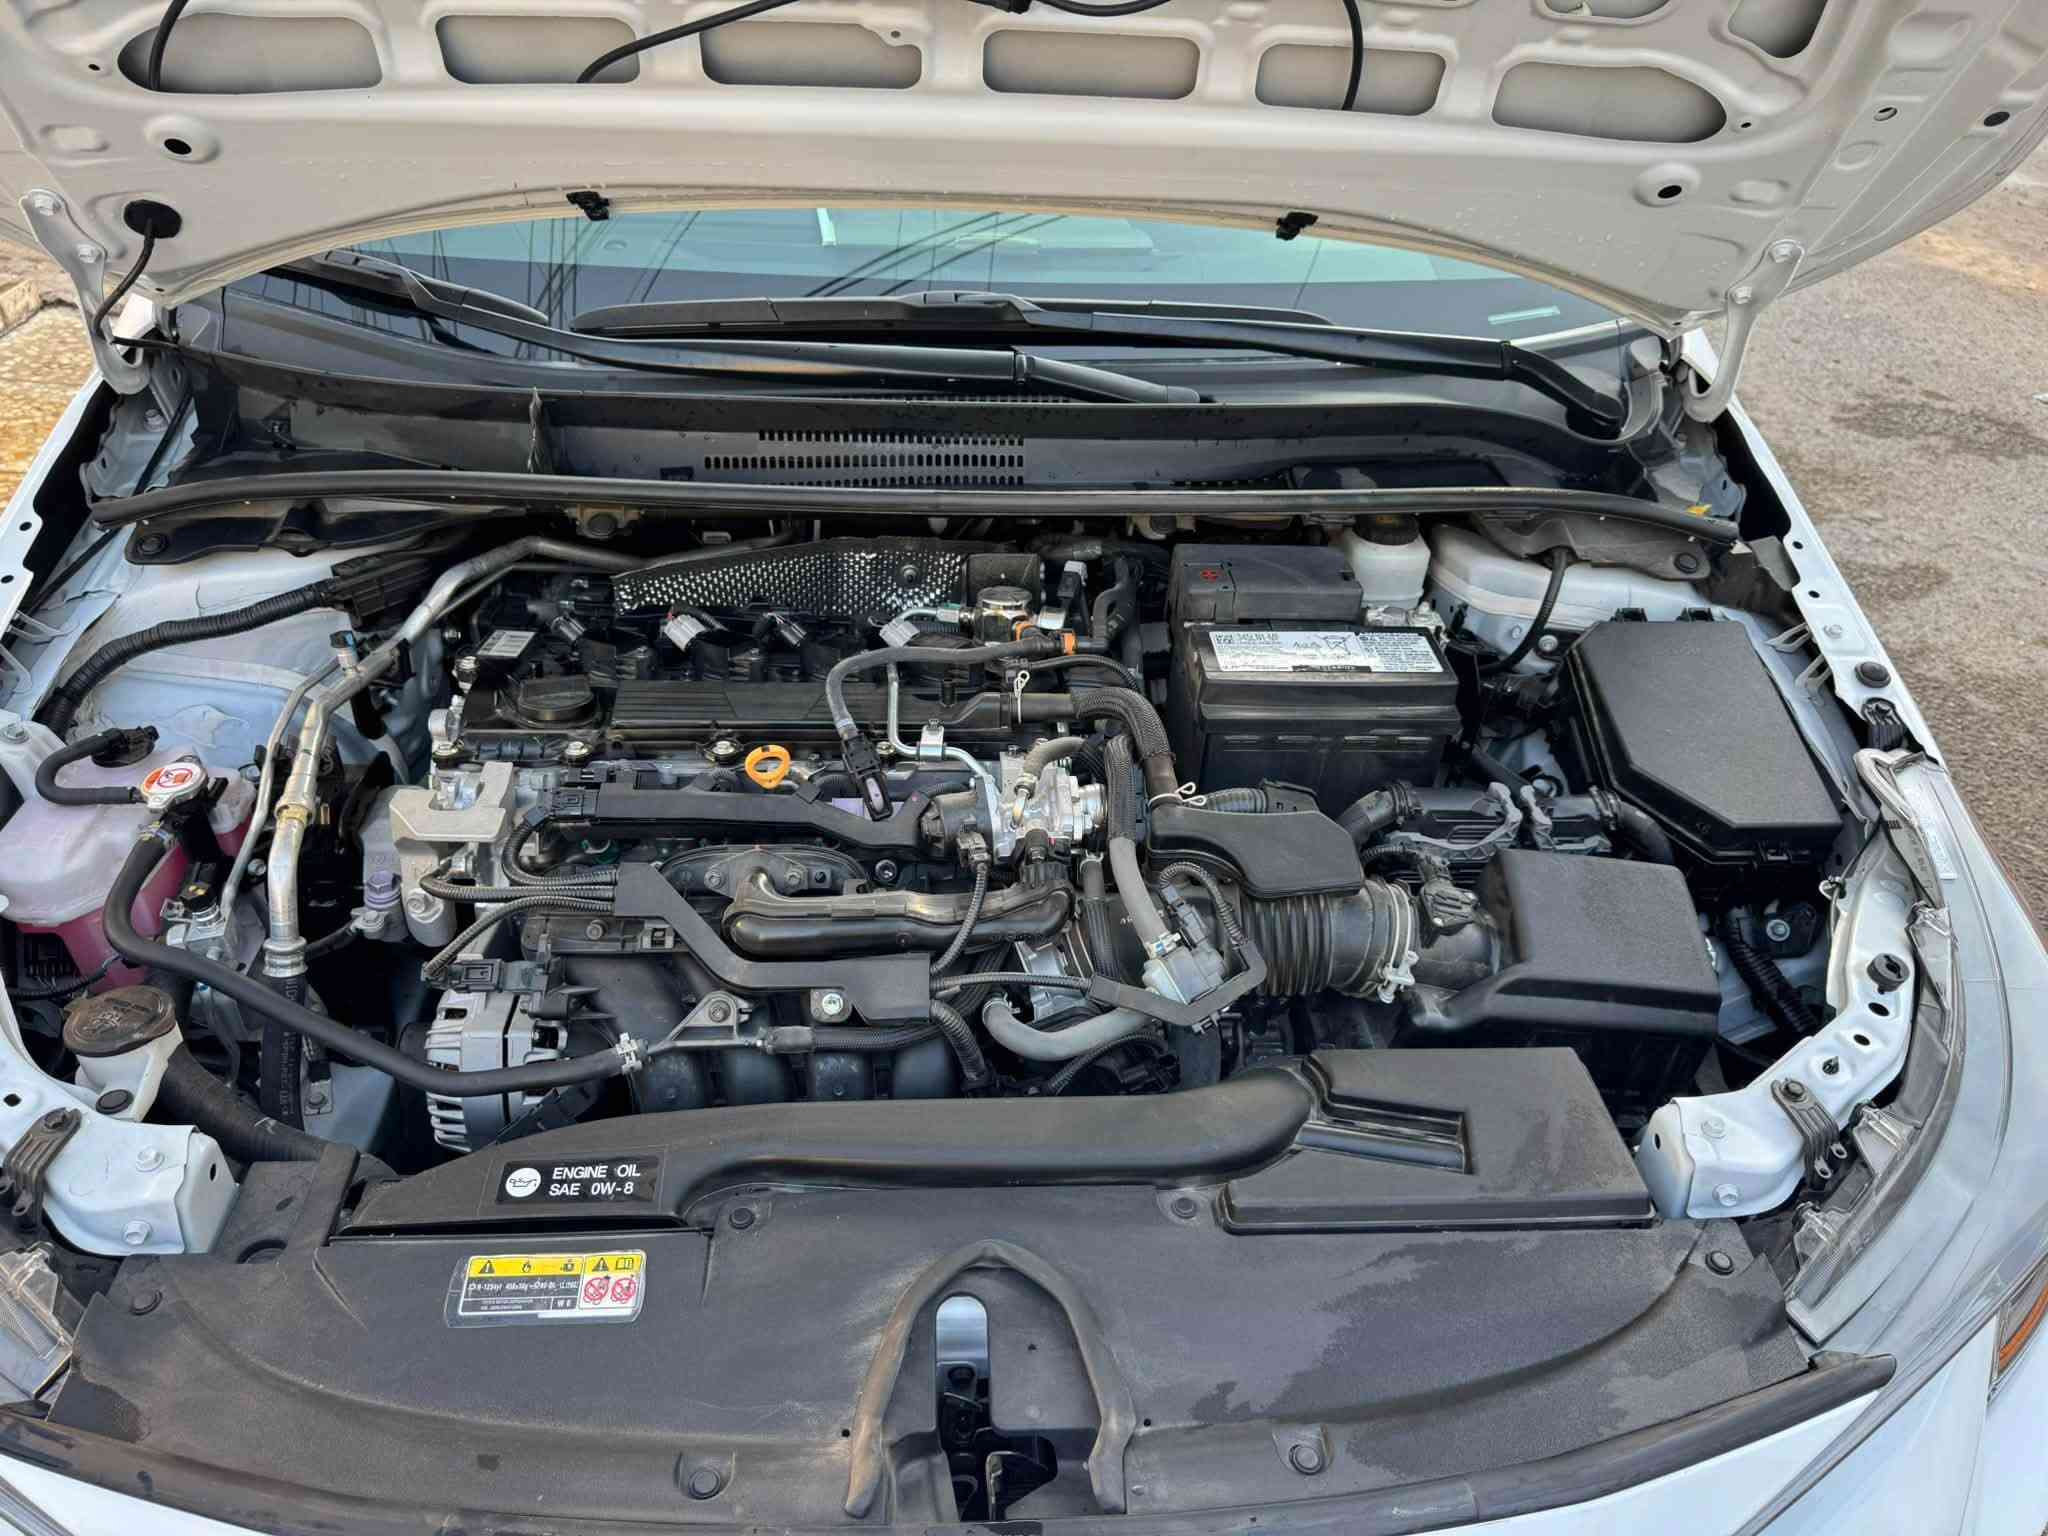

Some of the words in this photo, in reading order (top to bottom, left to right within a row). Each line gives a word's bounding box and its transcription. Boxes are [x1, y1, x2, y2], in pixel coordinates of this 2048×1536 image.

[552, 1165, 608, 1179] ENGINE
[617, 1164, 641, 1177] OIL
[549, 1183, 581, 1197] SAE
[591, 1181, 634, 1196] 0W-8
